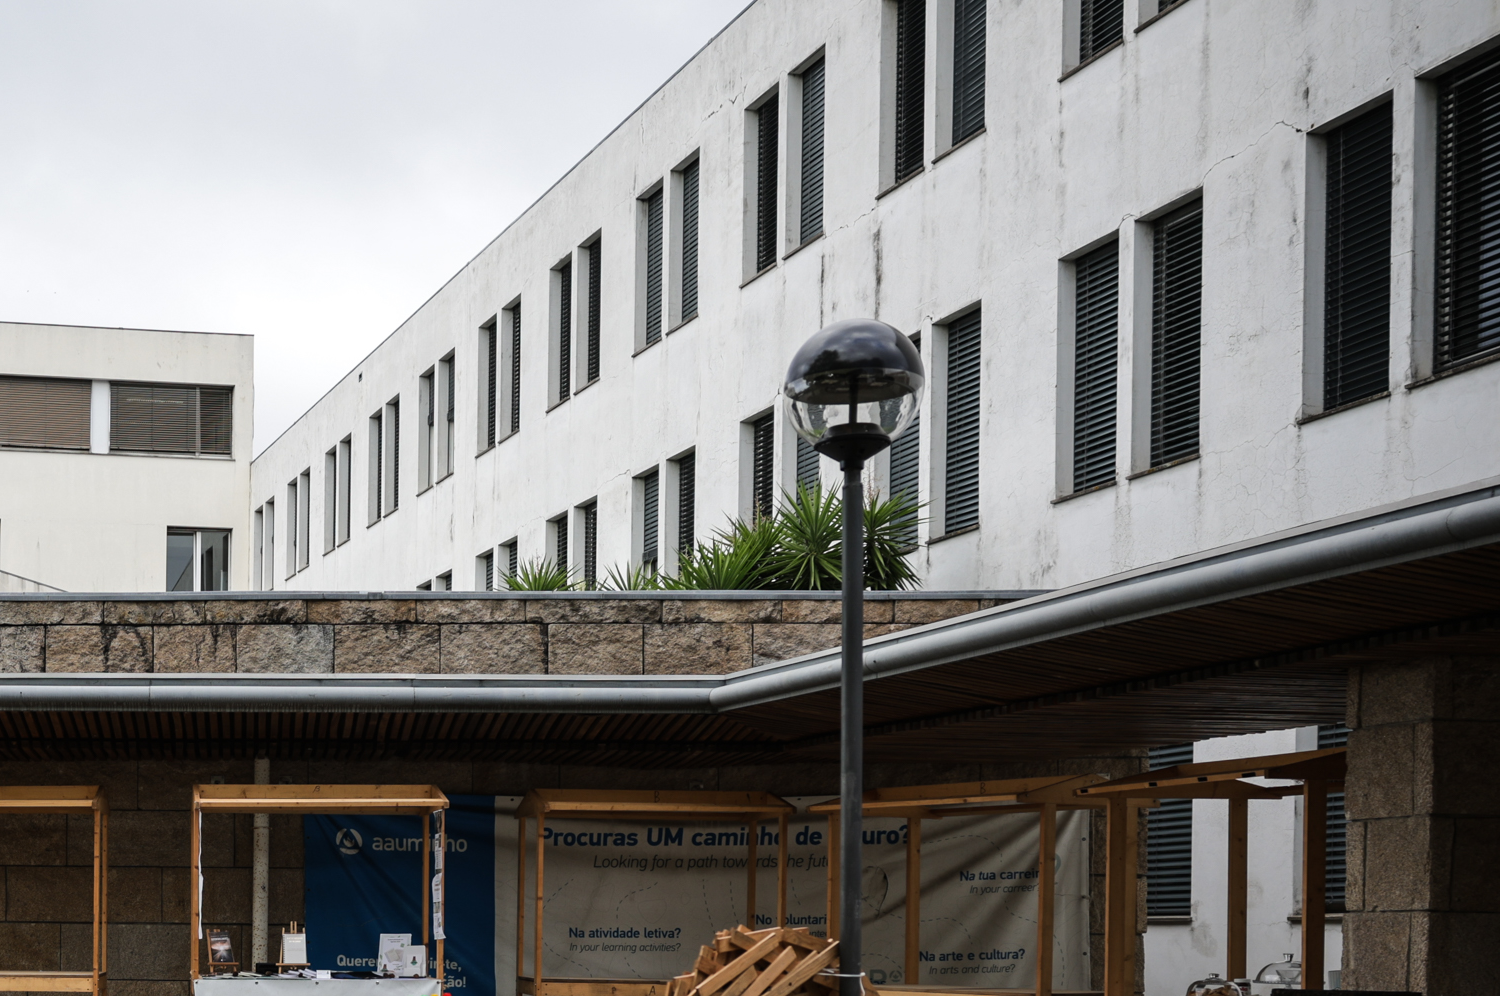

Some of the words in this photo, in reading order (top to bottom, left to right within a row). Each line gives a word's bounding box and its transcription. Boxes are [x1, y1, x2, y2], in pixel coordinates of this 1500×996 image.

[544, 828, 638, 846] Procuras
[646, 828, 684, 846] UM
[796, 826, 822, 846] de
[593, 855, 648, 872] Looking
[650, 854, 672, 871] for
[675, 858, 684, 868] a
[687, 855, 718, 871] path
[722, 854, 778, 868] towrds
[960, 871, 976, 881] Na
[979, 870, 996, 880] tua
[1000, 868, 1039, 880] carreir
[969, 884, 978, 894] In
[980, 884, 1000, 896] your
[756, 914, 772, 924] No
[568, 928, 584, 938] Na
[588, 927, 640, 938] atividade
[644, 928, 681, 938] letiva?
[570, 943, 578, 952] In
[580, 945, 600, 954] your
[602, 943, 636, 954] learning
[639, 943, 681, 952] activities?
[919, 952, 936, 962] Na
[938, 951, 963, 961] arte
[967, 952, 975, 961] e
[978, 948, 1026, 960] cultura?
[929, 966, 938, 975] In
[940, 966, 959, 975] arts
[961, 964, 979, 974] and
[982, 964, 1016, 974] culture?
